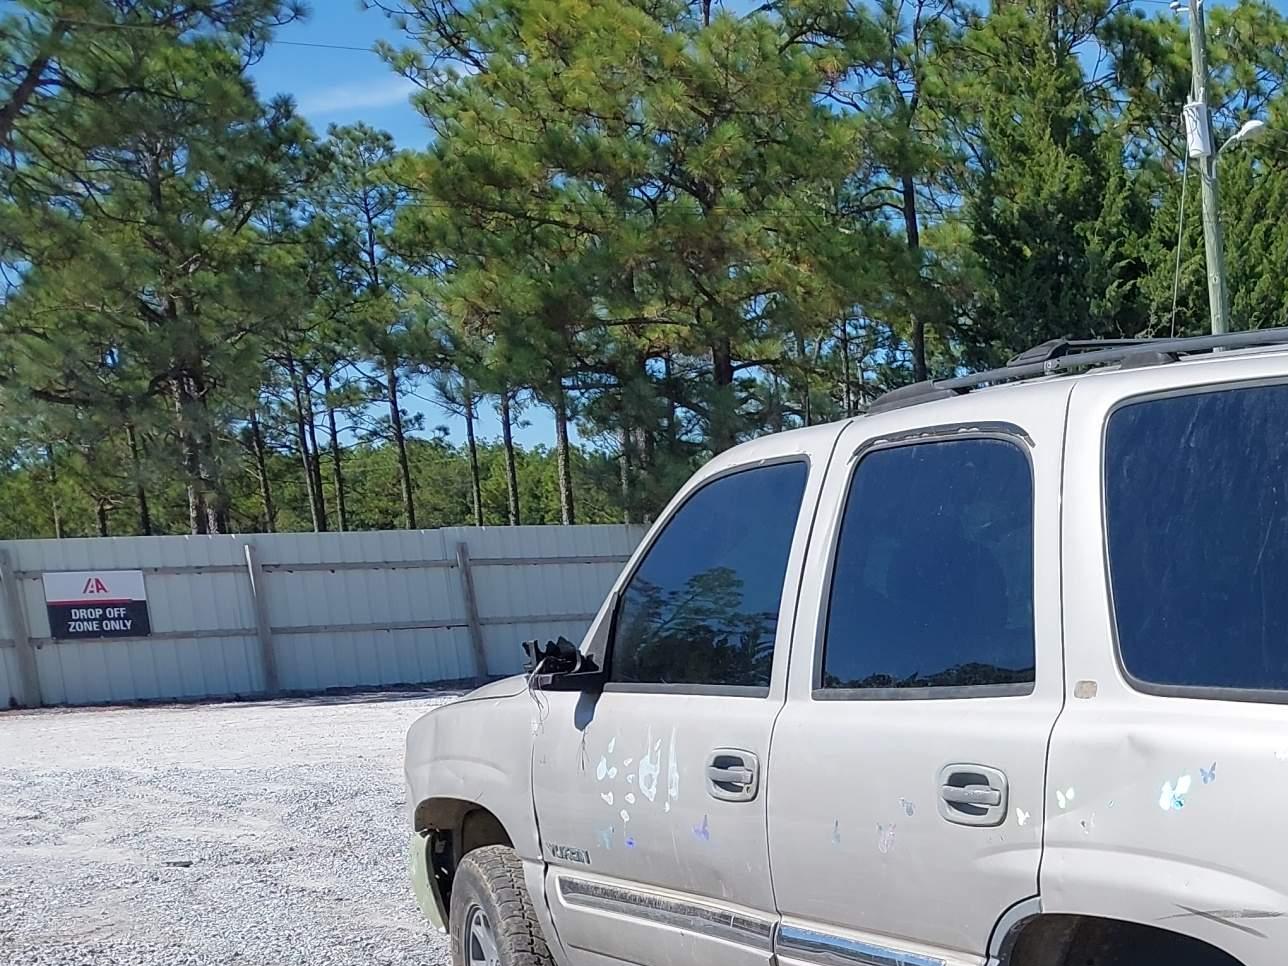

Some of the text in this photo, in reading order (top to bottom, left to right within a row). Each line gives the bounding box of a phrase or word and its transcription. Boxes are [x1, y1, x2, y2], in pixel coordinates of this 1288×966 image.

[71, 607, 126, 619] DROP OFF
[67, 619, 132, 632] ZONE ONLY
